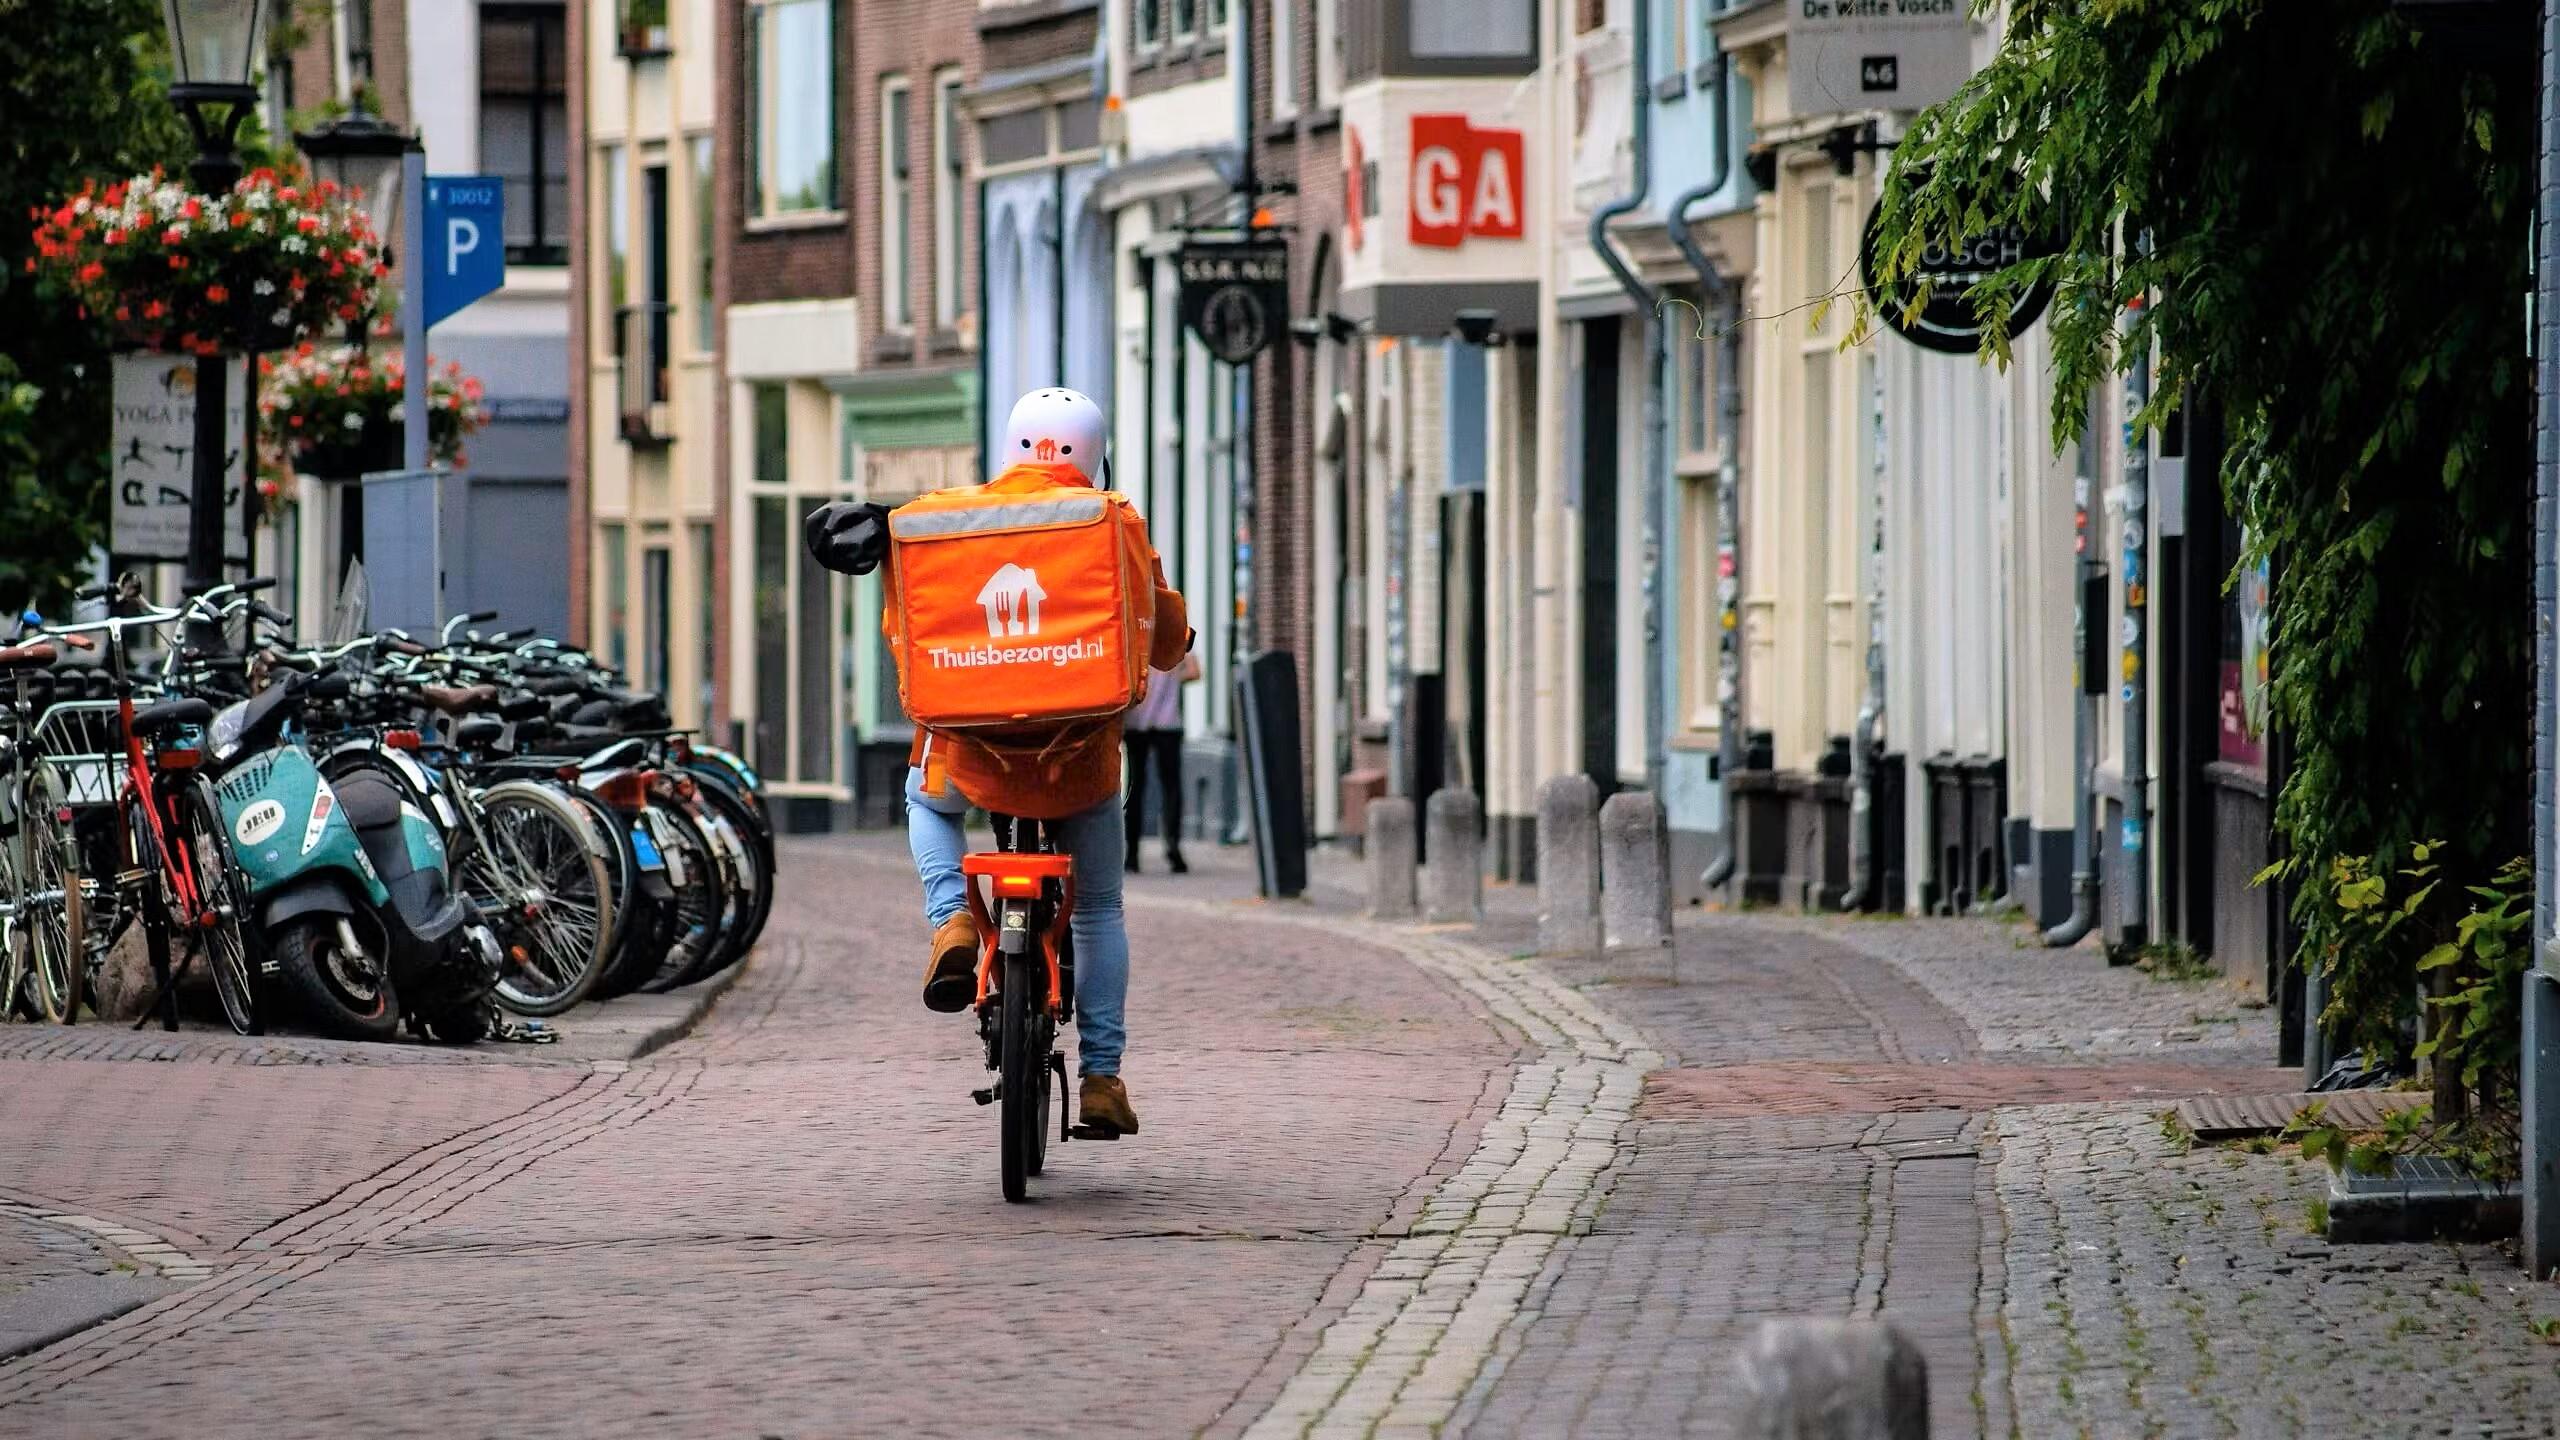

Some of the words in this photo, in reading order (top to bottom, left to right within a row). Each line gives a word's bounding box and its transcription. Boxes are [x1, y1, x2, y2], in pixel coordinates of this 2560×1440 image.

[1804, 0, 1829, 17] De
[1835, 0, 1889, 16] Witte
[1896, 0, 1955, 15] Vosch
[1864, 63, 1894, 84] 46
[1415, 145, 1516, 228] GA
[448, 217, 479, 277] P
[1922, 240, 2022, 266] OSCH
[928, 636, 1103, 669] Thuisbezorgd.nl
